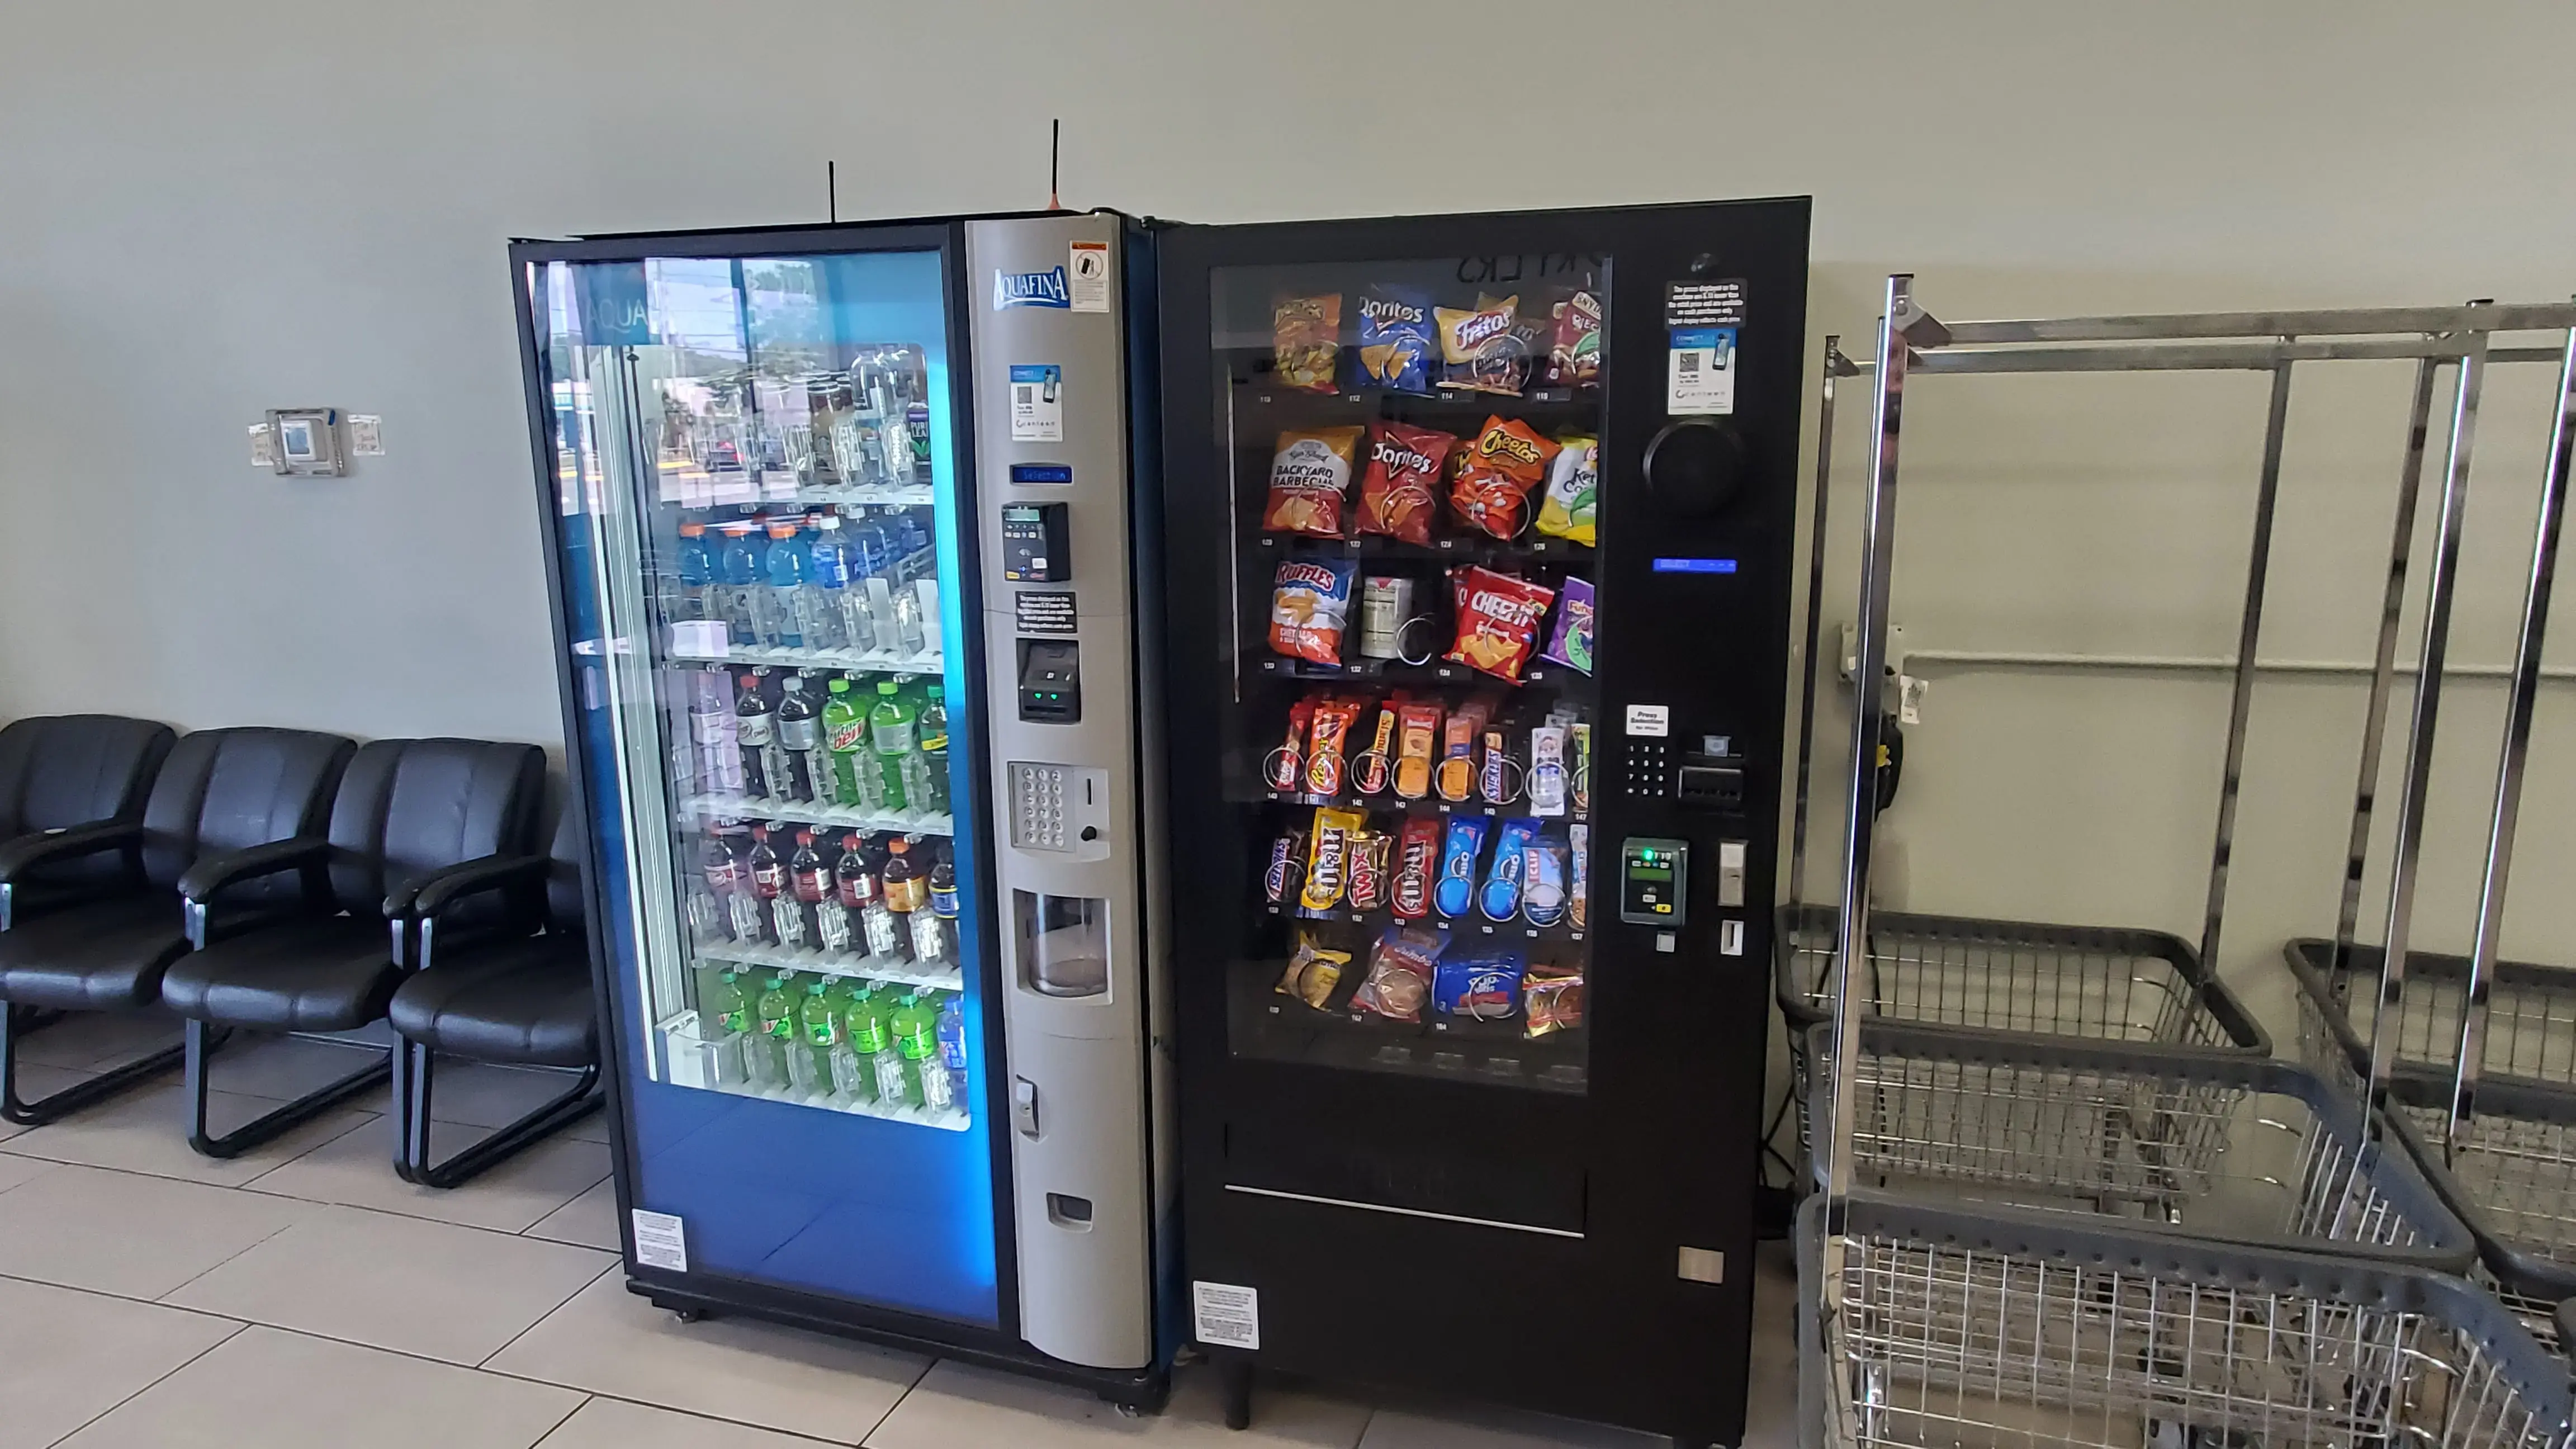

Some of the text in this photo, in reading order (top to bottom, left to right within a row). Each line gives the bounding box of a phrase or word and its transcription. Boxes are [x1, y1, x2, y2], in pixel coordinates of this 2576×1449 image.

[995, 268, 1068, 301] AQUAFINA
[1359, 296, 1424, 323] Doritos
[1454, 312, 1511, 350] Fritos
[1371, 442, 1432, 474] Doritos
[1481, 428, 1541, 466] Cheetos
[1276, 465, 1334, 479] BACKYARD
[1275, 561, 1336, 591] RUFFLES
[1352, 851, 1376, 906] TWIX
